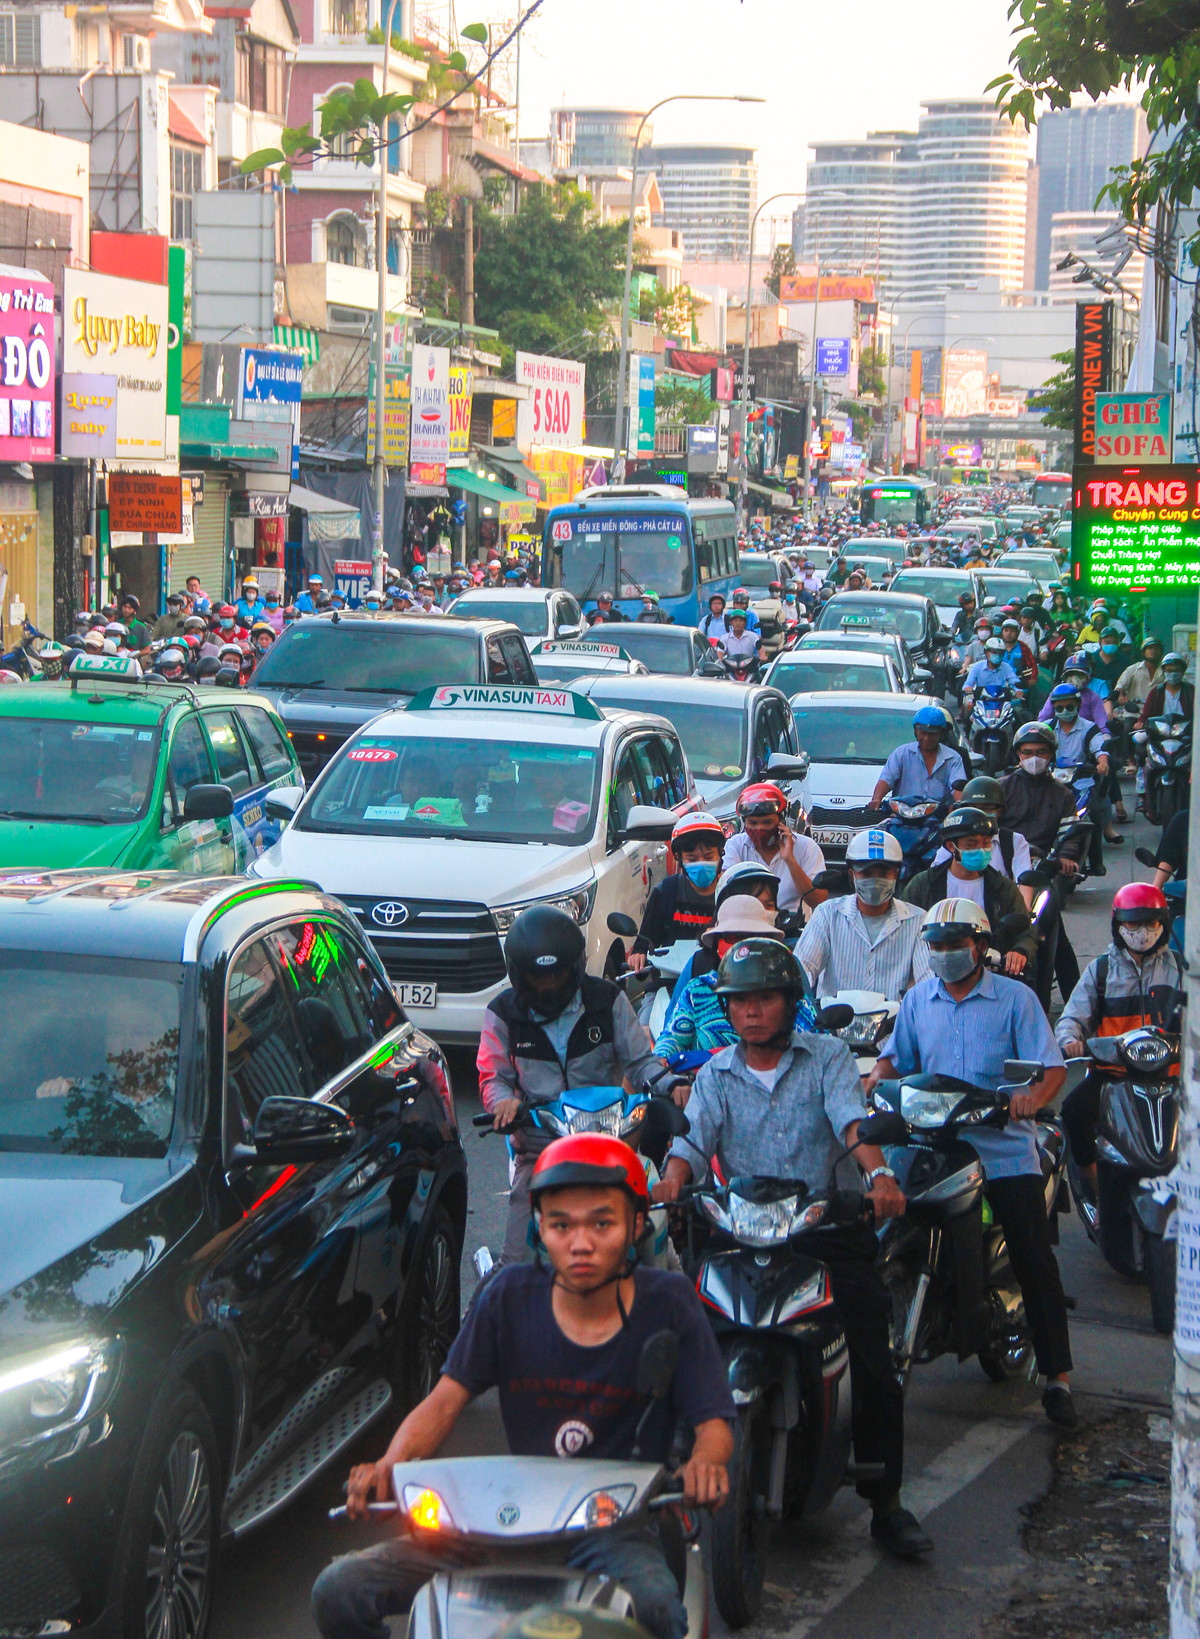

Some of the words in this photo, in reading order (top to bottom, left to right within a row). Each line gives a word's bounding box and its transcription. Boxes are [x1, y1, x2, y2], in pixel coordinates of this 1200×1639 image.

[123, 314, 161, 360] Baby
[66, 392, 114, 411] Luxry
[1102, 395, 1165, 424] GHẾ
[534, 388, 541, 432] 5
[545, 387, 570, 434] SAO
[70, 421, 107, 437] Baby
[1097, 435, 1167, 456] SOFA
[1087, 481, 1187, 507] TRANG
[1113, 508, 1156, 522] Chuyên
[1159, 508, 1188, 522] Cung
[554, 522, 570, 539] 43
[577, 520, 590, 532] BẾN
[592, 522, 600, 532] XE
[643, 520, 656, 531] PHÀ
[1092, 538, 1110, 546] Kinh
[1091, 563, 1110, 573] Máy
[1136, 563, 1155, 571] Kinh
[1164, 562, 1184, 573] Máy
[351, 751, 391, 760] 10474
